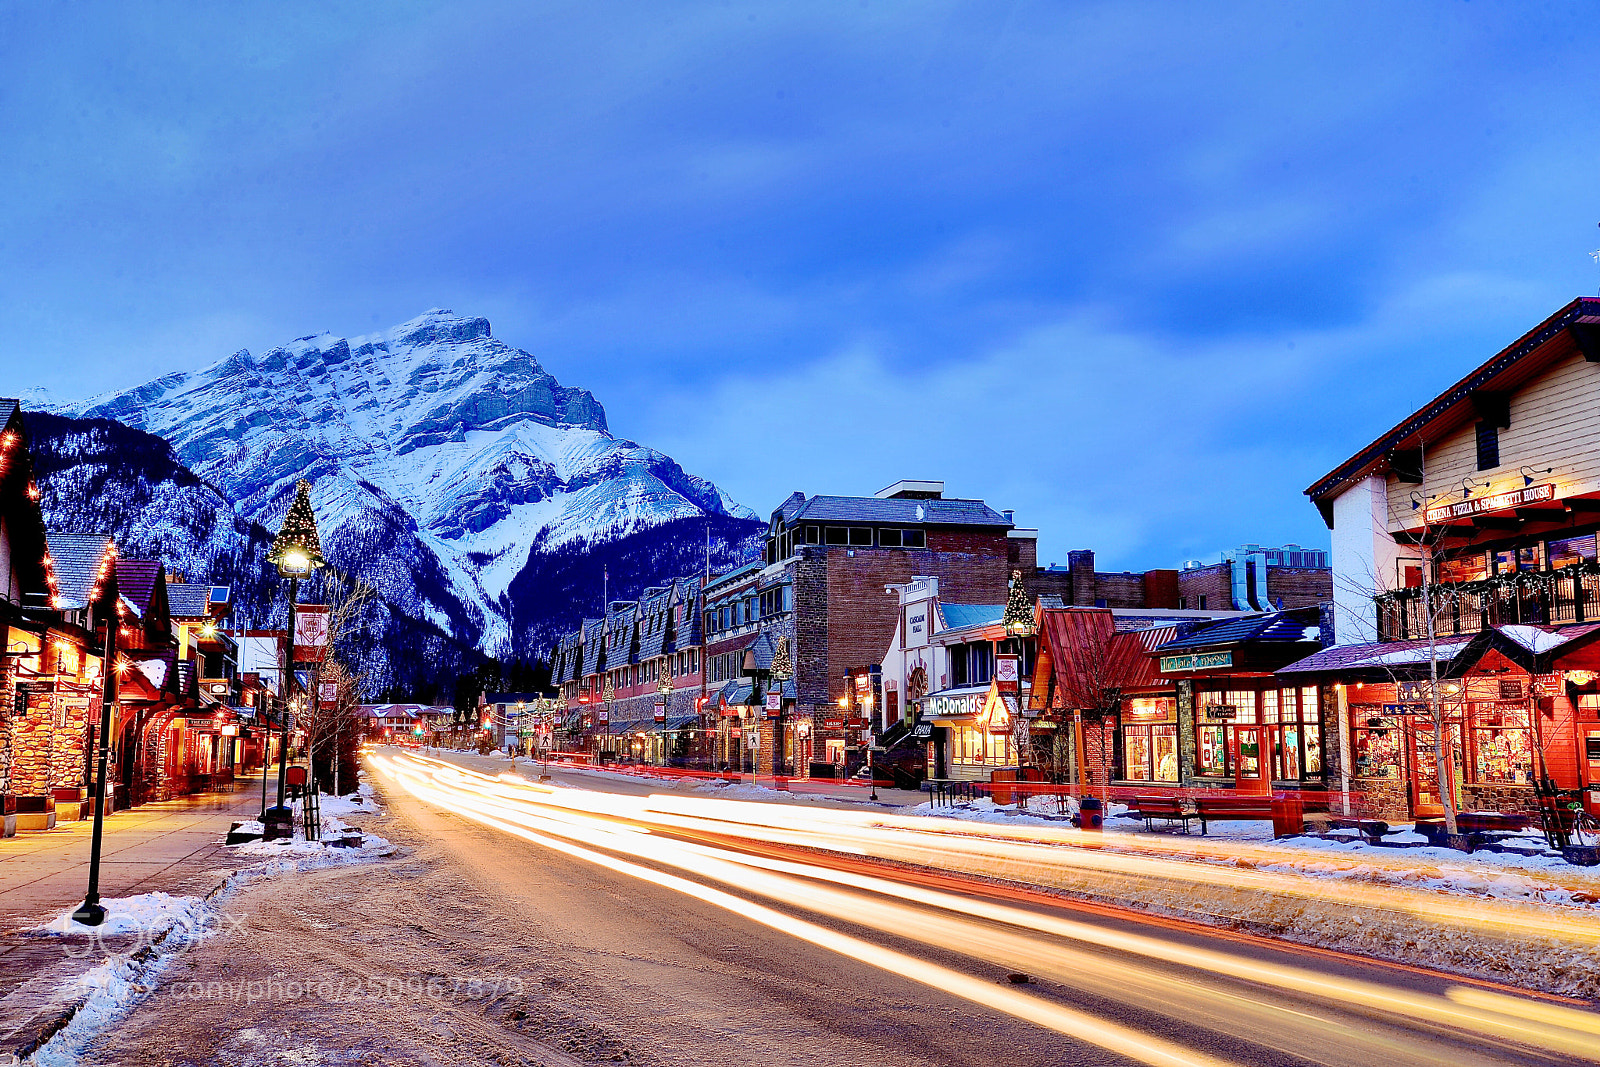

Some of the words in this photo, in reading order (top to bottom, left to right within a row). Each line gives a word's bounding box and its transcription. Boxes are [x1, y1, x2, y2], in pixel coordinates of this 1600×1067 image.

[1453, 502, 1474, 516] PIZZA
[1475, 500, 1481, 511] &
[1481, 492, 1522, 510] SPAGHETTI
[1523, 485, 1550, 502] HOUSE
[929, 695, 983, 714] McDonald's
